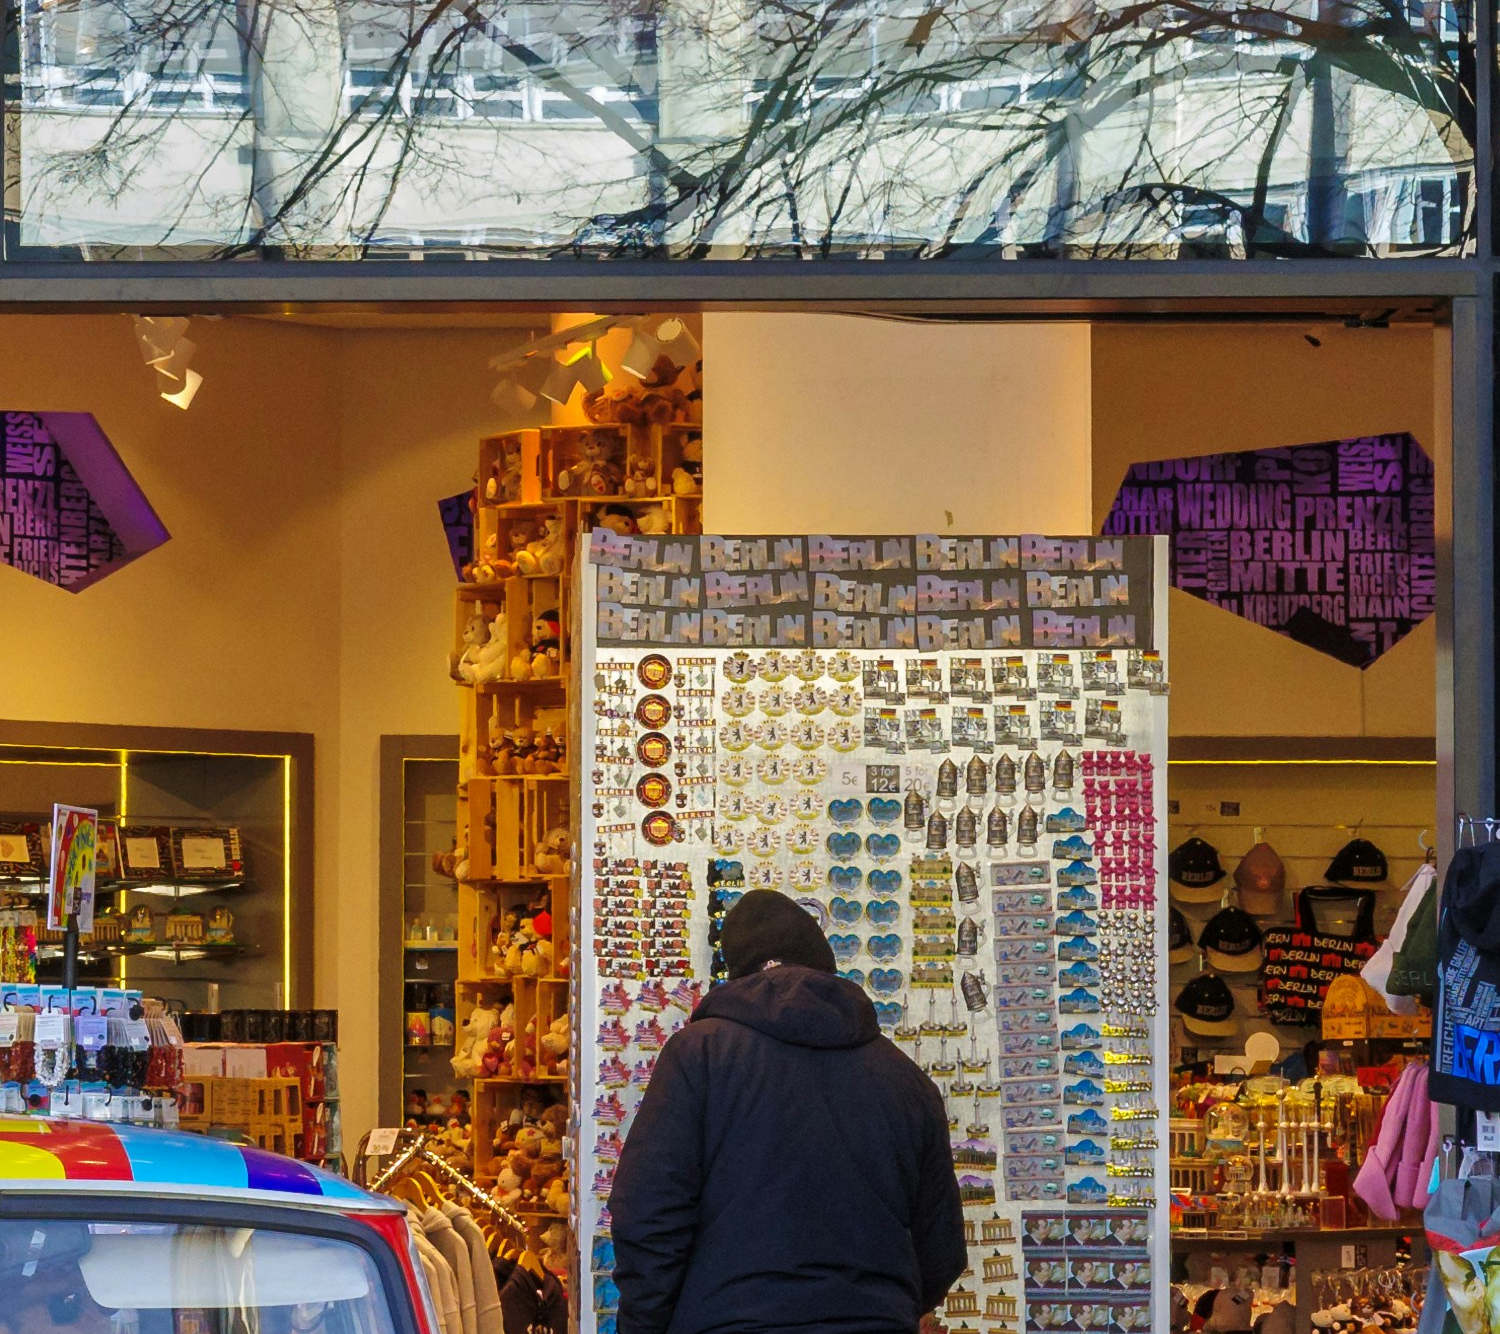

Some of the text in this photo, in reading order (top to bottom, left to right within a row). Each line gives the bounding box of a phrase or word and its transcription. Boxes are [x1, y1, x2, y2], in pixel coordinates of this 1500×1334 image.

[6, 411, 34, 473] WEISS
[13, 513, 58, 537] BERG
[1178, 483, 1291, 531] WEDDING
[14, 537, 59, 563] FRIED
[589, 527, 693, 575] BERLIN
[700, 534, 802, 571] BERLIN
[809, 534, 912, 571] BERLIN
[916, 533, 1019, 571] BERLIN
[1020, 534, 1124, 571] BERLIN
[1230, 530, 1345, 562] BERLIN
[1349, 528, 1408, 550] BERG
[1177, 531, 1207, 588] TIER
[1230, 562, 1345, 593] MITTE
[1350, 552, 1409, 575] FRIED
[597, 567, 700, 608] BERLIN
[704, 571, 809, 609] BERLIN
[813, 572, 916, 613] BERLIN
[917, 575, 1020, 612] BERLIN
[1026, 572, 1129, 608] BERLIN
[1350, 574, 1409, 597] RICHS
[599, 601, 700, 644] BERLIN
[1350, 595, 1409, 618] HAIN
[702, 608, 805, 646] BERLIN
[812, 610, 915, 649] BERLIN
[917, 615, 1020, 652] BERLIN
[1032, 610, 1136, 647] BERLIN
[842, 772, 858, 786] 5€
[871, 766, 895, 776] 3 for
[871, 778, 897, 792] 12€
[916, 767, 928, 776] for
[1281, 951, 1320, 963] BERLIN
[1314, 937, 1353, 952] BERLIN
[1278, 981, 1317, 994] BERLIN
